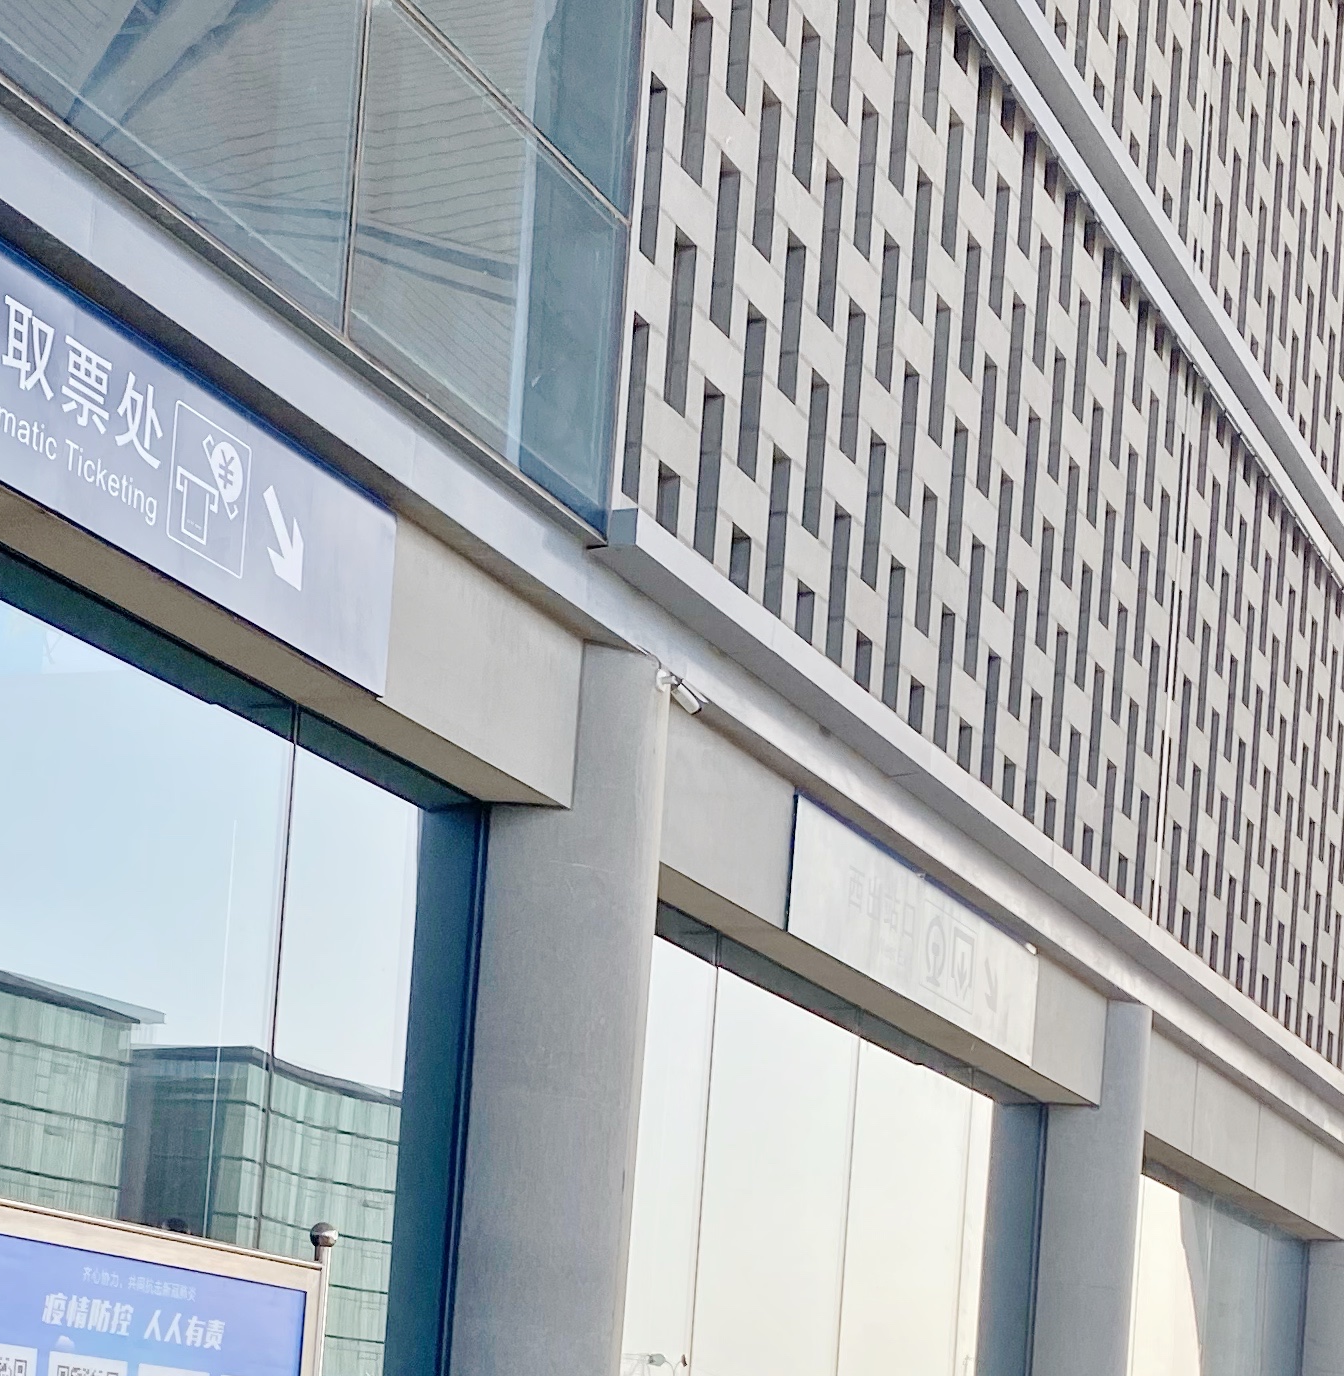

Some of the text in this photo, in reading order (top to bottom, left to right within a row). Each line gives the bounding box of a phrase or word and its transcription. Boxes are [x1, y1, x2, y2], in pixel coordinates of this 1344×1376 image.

[65, 439, 158, 526] Ticketing
[42, 1292, 225, 1351] 疫情防控 人人有责
